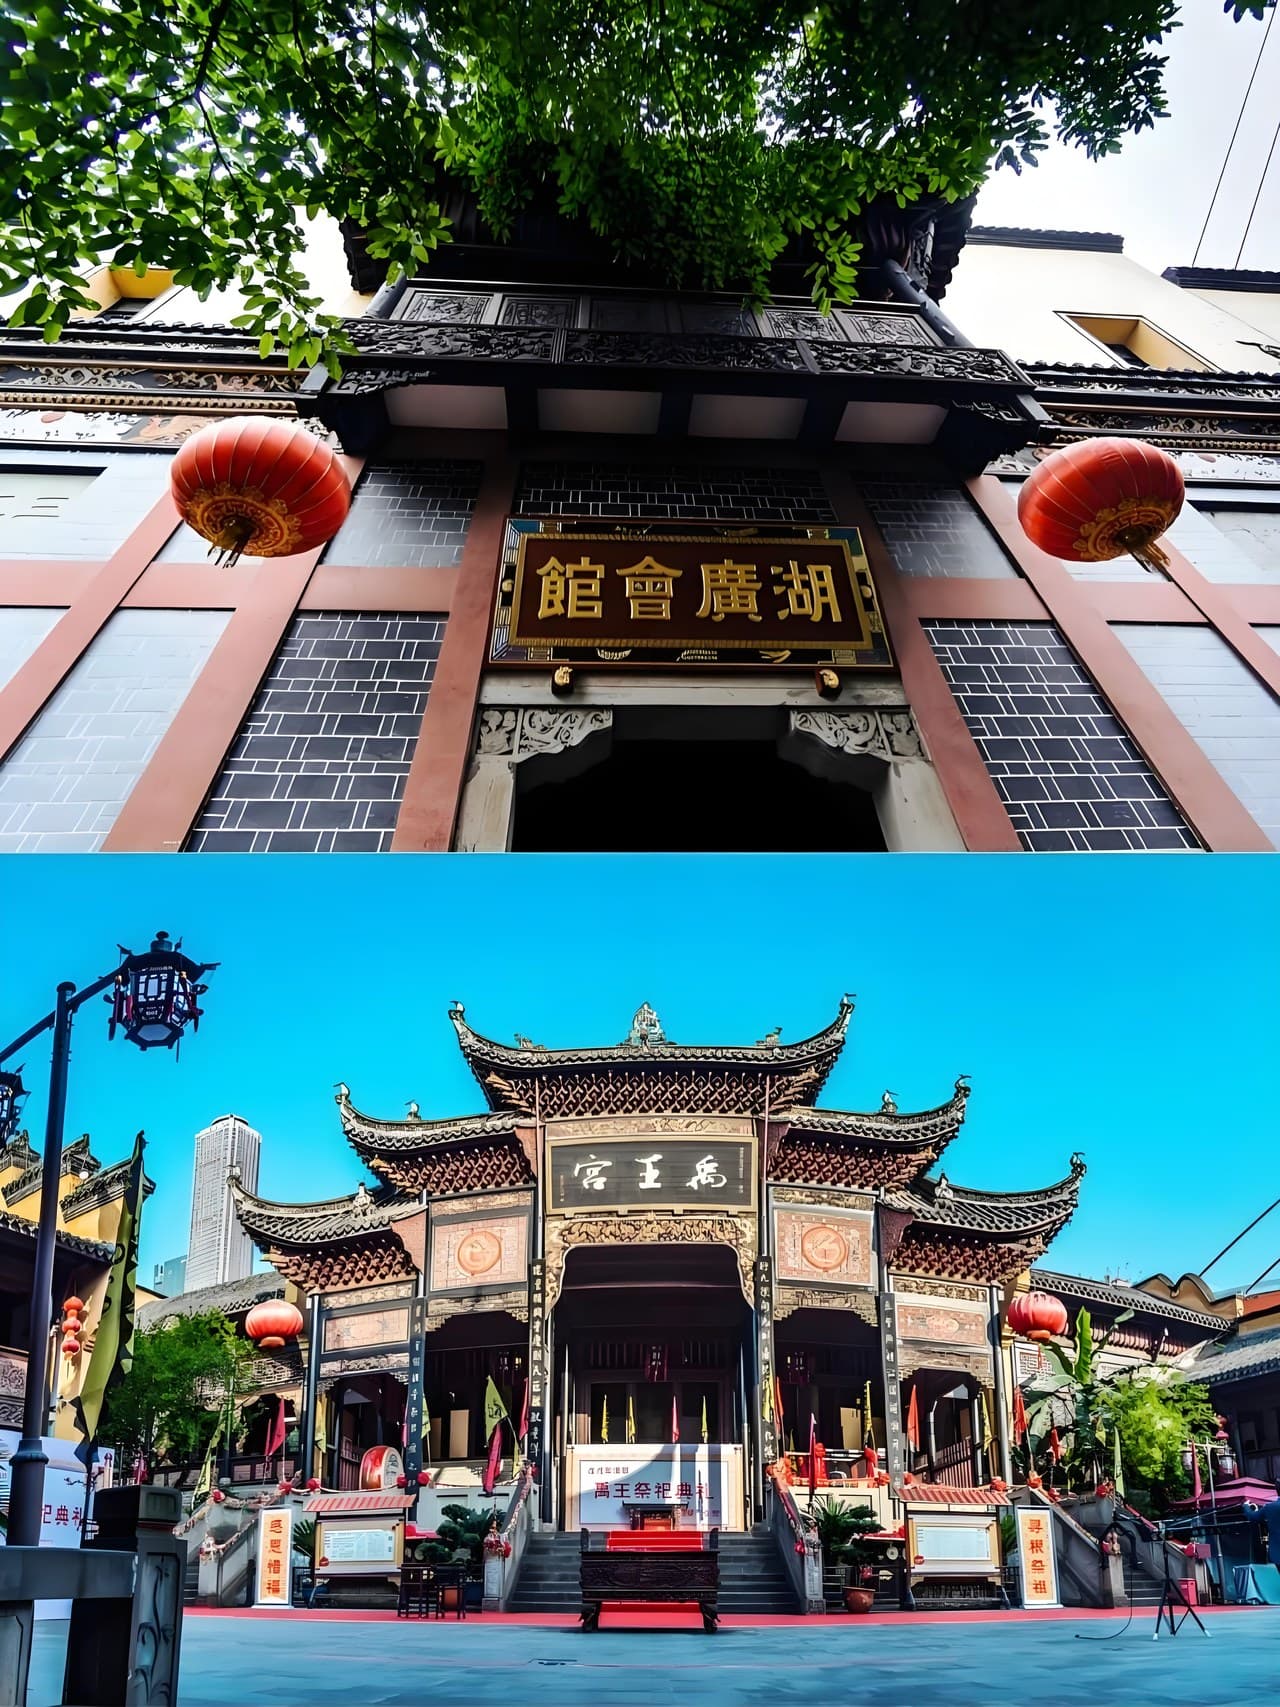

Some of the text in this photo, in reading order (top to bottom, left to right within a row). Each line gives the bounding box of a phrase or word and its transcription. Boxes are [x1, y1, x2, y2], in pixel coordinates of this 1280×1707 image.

[536, 555, 842, 623] 湖廣會館
[594, 1481, 715, 1500] 禹王祭祀典礼
